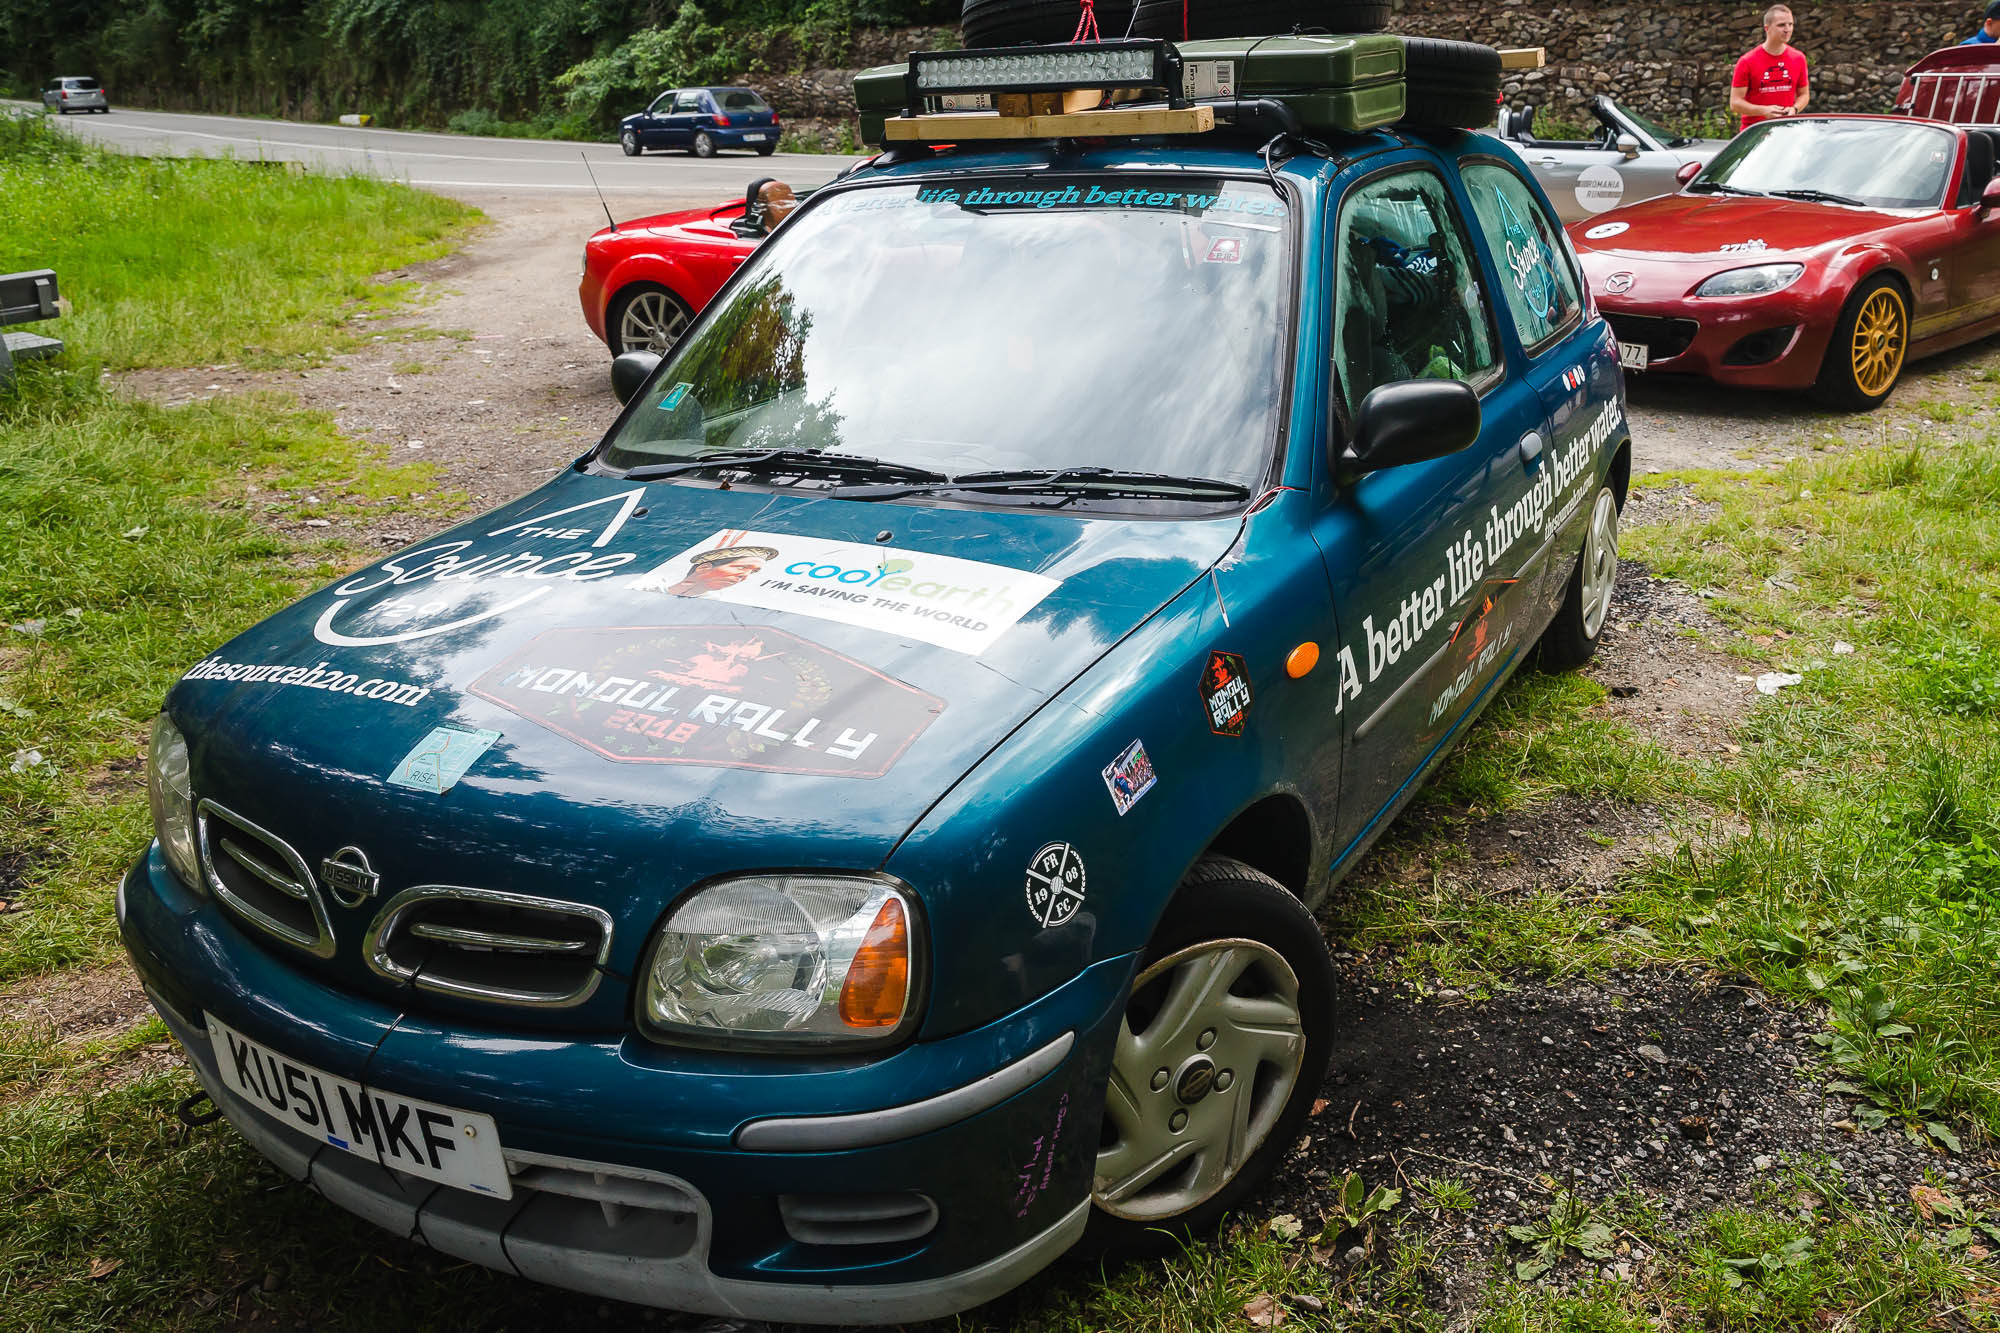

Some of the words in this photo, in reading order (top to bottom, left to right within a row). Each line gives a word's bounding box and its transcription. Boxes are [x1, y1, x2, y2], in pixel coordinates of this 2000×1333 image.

[919, 188, 961, 204] life
[964, 186, 1081, 209] through
[1083, 185, 1184, 206] better
[1186, 193, 1286, 217] water.
[1505, 236, 1540, 291] Source
[515, 527, 592, 540] THE
[334, 540, 637, 596] Source
[1335, 645, 1363, 715] A
[1363, 573, 1446, 683] better
[1446, 529, 1484, 607] life
[1486, 460, 1554, 567] through
[1551, 433, 1591, 498] better
[1589, 394, 1623, 454] water.
[759, 579, 792, 591] I'M
[793, 584, 869, 604] SAVING
[871, 597, 914, 613] THE
[913, 606, 989, 632] WORLD
[182, 656, 431, 706] thesourceh2o.com
[1208, 675, 1247, 711] MONGUL
[500, 663, 680, 716] MONGUL
[688, 694, 880, 761] RALLY
[1213, 687, 1251, 728] RALLY
[602, 709, 701, 743] 2018
[410, 770, 436, 784] RISE
[324, 863, 369, 889] NISSAN
[1042, 853, 1059, 873] FR
[1065, 866, 1078, 883] 08
[1034, 888, 1048, 905] 19
[1055, 898, 1071, 918] FC
[225, 1031, 336, 1135] KU51
[337, 1084, 457, 1170] MKF
